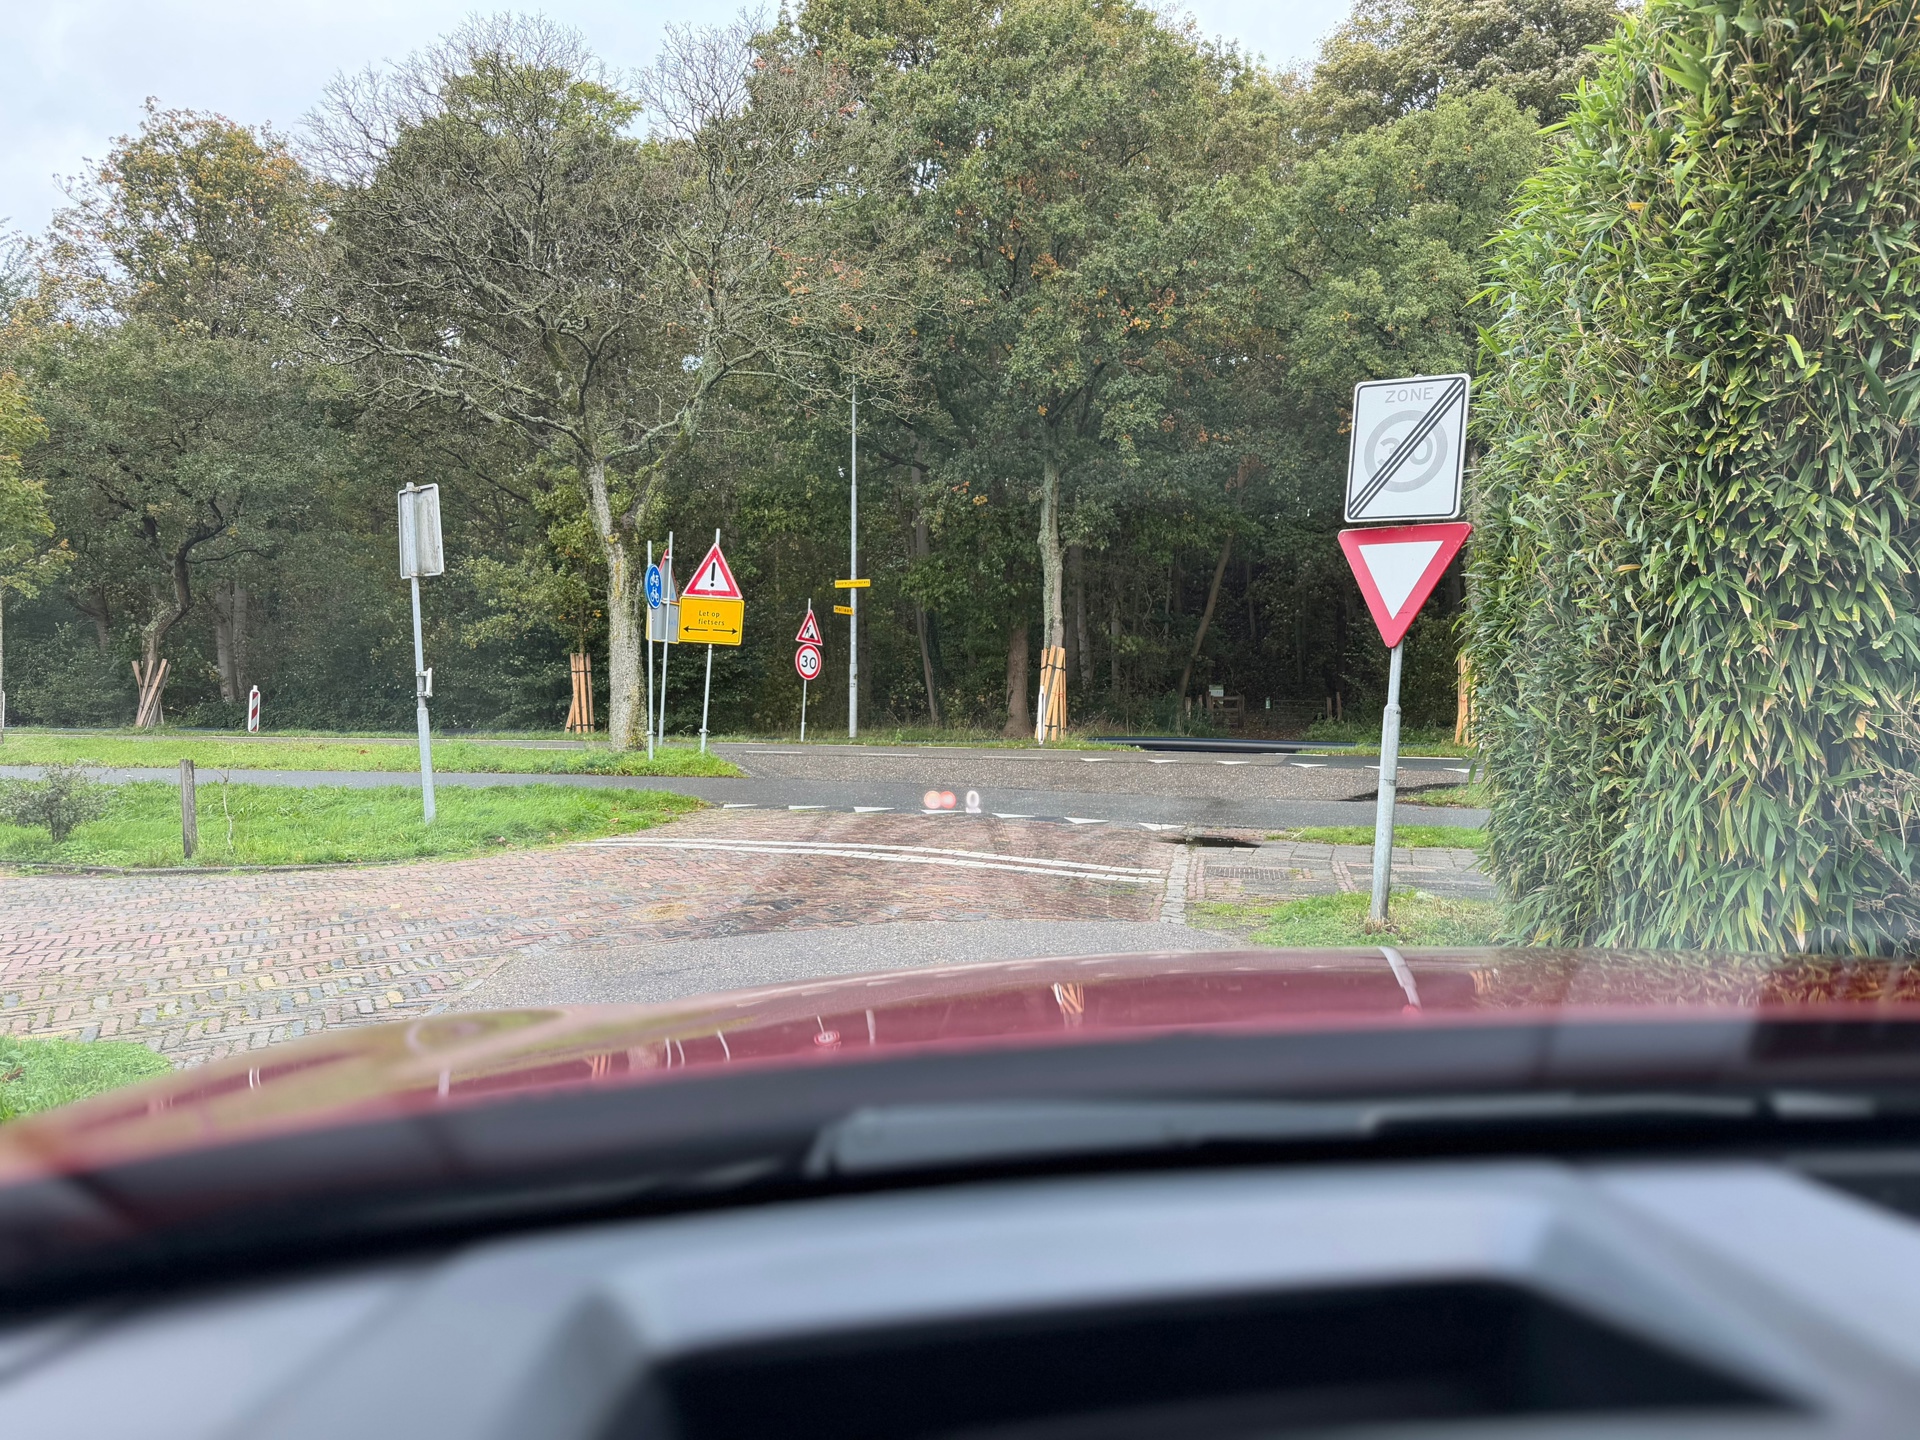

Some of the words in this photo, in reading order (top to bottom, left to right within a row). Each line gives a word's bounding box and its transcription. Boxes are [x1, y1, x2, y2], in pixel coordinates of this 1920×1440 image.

[1384, 387, 1435, 404] ZONE
[711, 611, 721, 619] op
[698, 618, 726, 627] fietsers
[801, 655, 817, 670] 30
